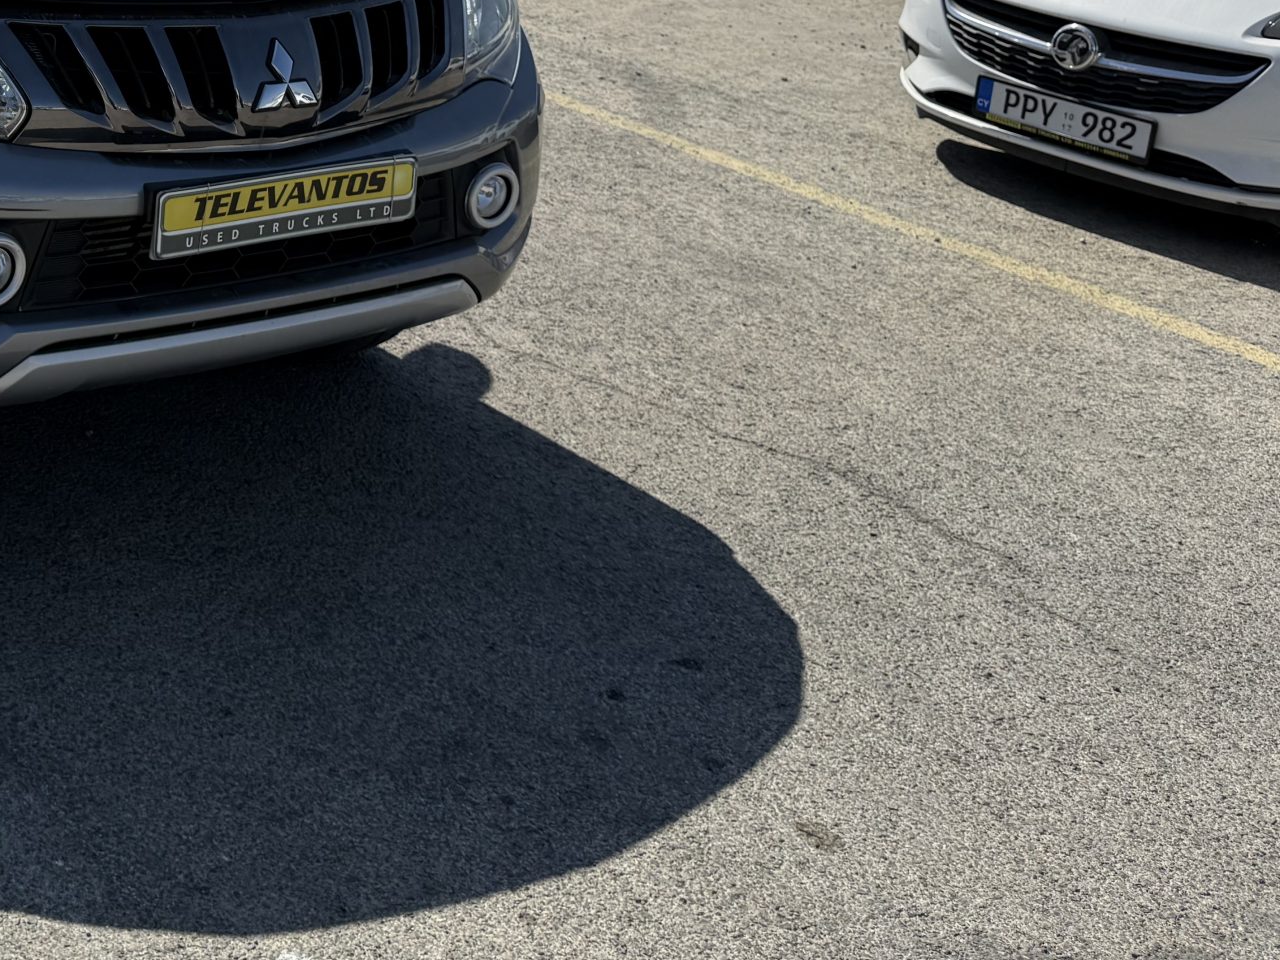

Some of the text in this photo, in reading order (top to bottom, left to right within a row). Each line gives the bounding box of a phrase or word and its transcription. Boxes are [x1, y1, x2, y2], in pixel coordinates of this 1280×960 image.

[977, 98, 990, 106] CY
[1003, 88, 1058, 126] PPY
[1081, 111, 1137, 150] 982
[193, 169, 389, 221] TELEVANTOS
[185, 204, 391, 248] USED TRUCKS LTD
